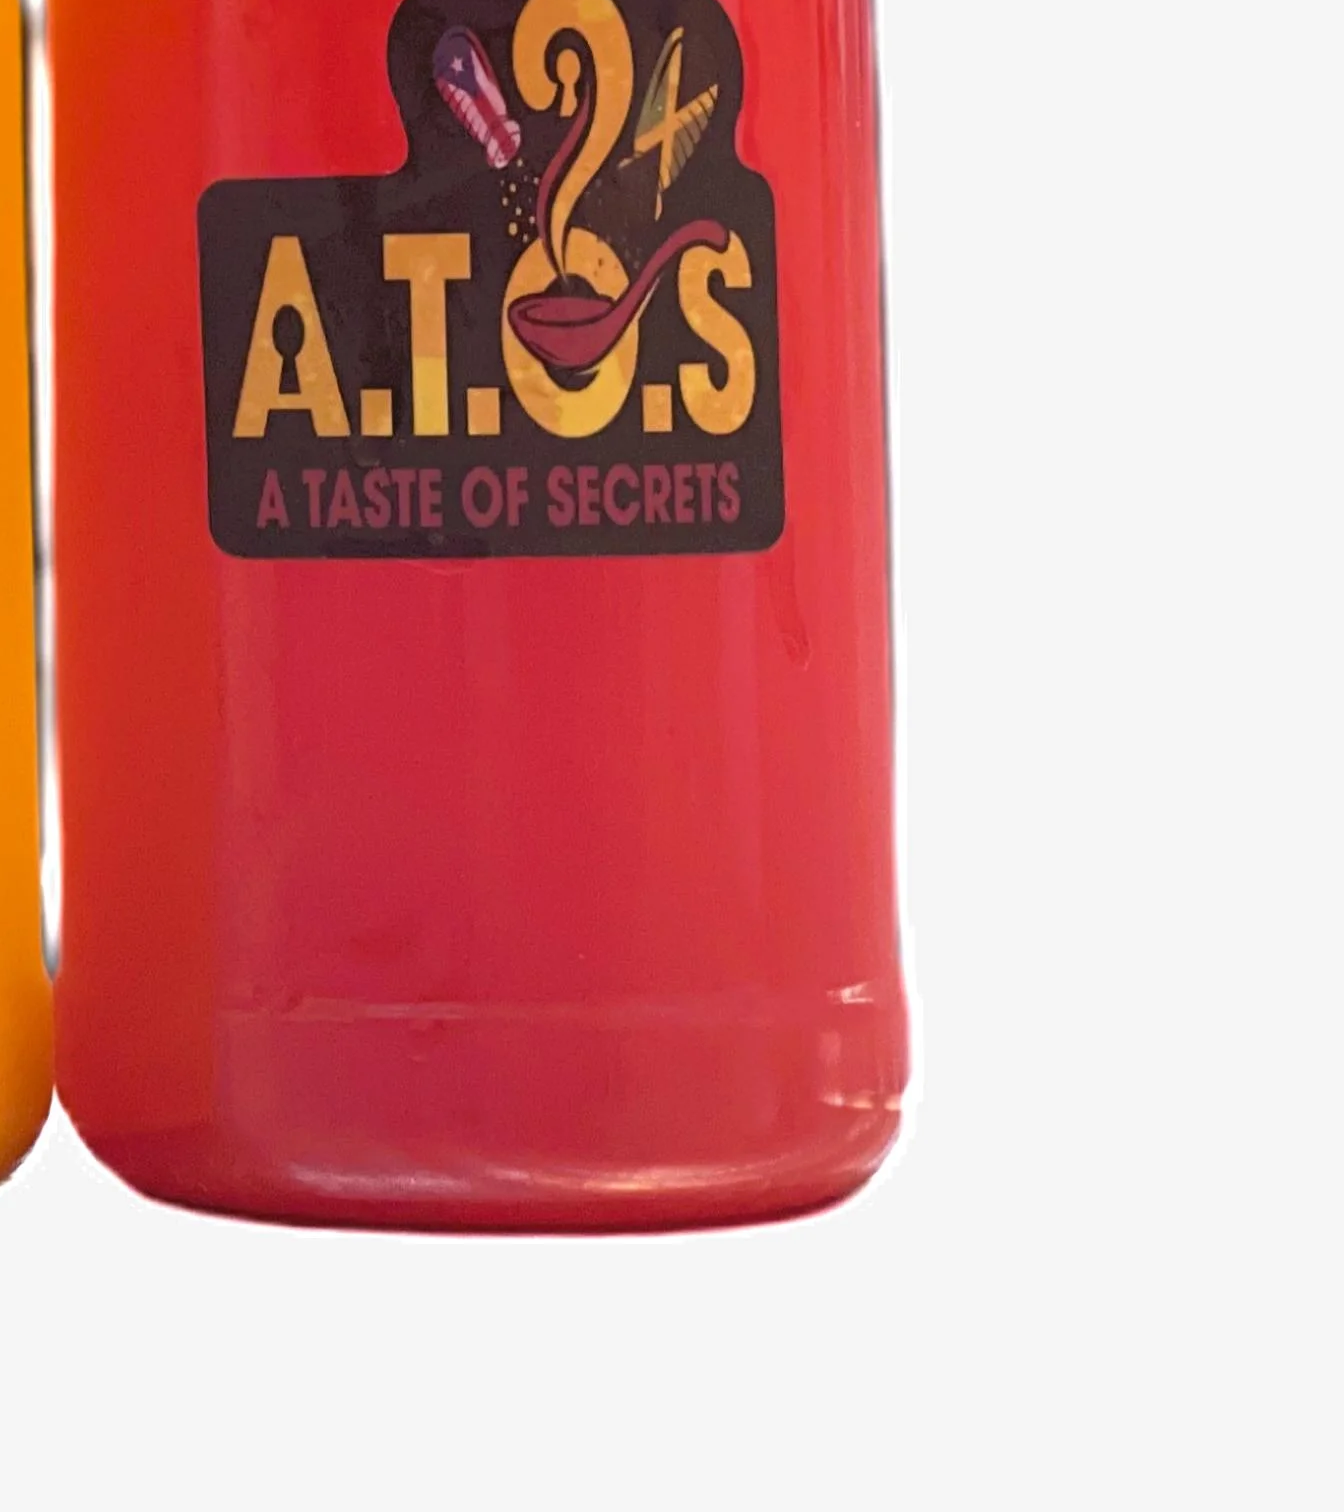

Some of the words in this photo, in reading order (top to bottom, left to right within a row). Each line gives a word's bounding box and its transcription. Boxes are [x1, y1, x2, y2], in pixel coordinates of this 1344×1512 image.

[232, 226, 755, 437] A.T.O.S
[256, 470, 289, 528] A
[303, 466, 442, 528] TASTE
[461, 466, 527, 526] OF
[547, 462, 741, 525] SECRETS
